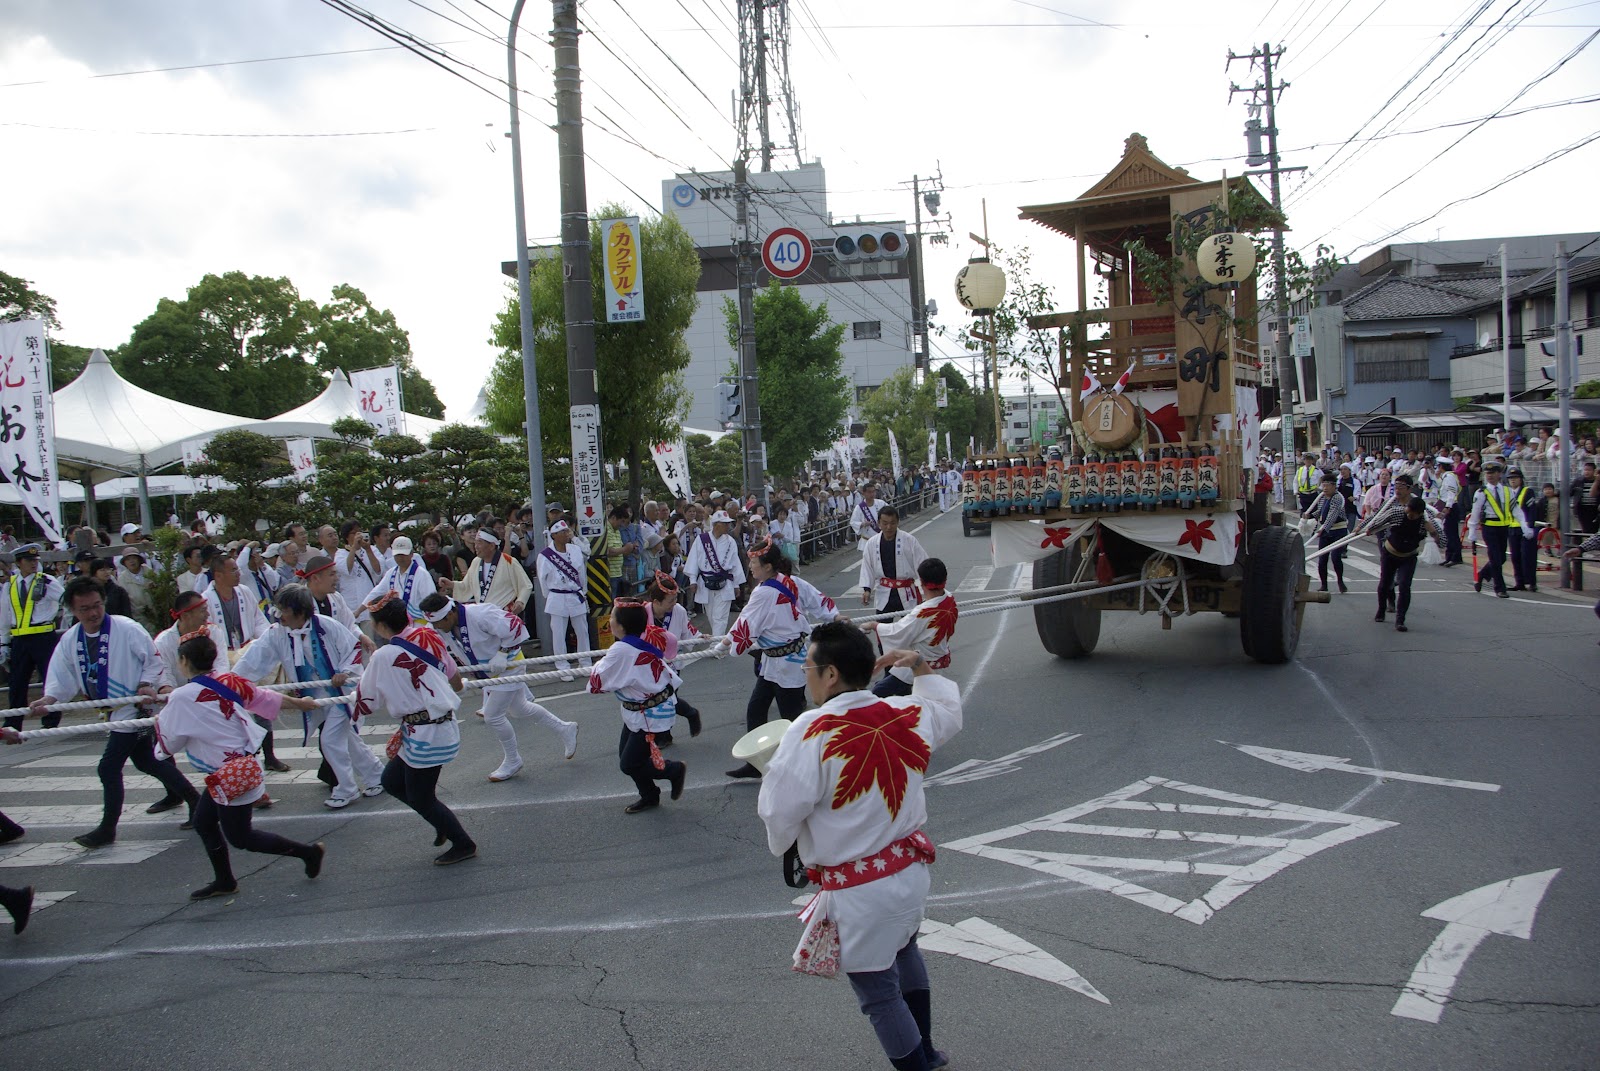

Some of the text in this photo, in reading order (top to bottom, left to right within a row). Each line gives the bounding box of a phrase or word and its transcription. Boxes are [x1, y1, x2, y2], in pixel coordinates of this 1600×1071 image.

[613, 232, 633, 290] カクテル
[774, 240, 801, 264] 40
[1213, 233, 1236, 279] 岡本町
[578, 451, 591, 505] 宇治山田店
[587, 422, 600, 499] ドコモショップ
[1161, 460, 1175, 496] 江楓会
[1179, 459, 1194, 496] 岡本町
[1198, 458, 1214, 496] 江楓会
[963, 472, 976, 506] 岡本町
[995, 470, 1008, 503] 岡本町
[1031, 468, 1044, 503] 岡本町
[1069, 466, 1082, 502] 岡本町
[1104, 465, 1118, 501] 岡本町
[1122, 463, 1136, 499] 江楓会
[1142, 463, 1156, 499] 岡本町
